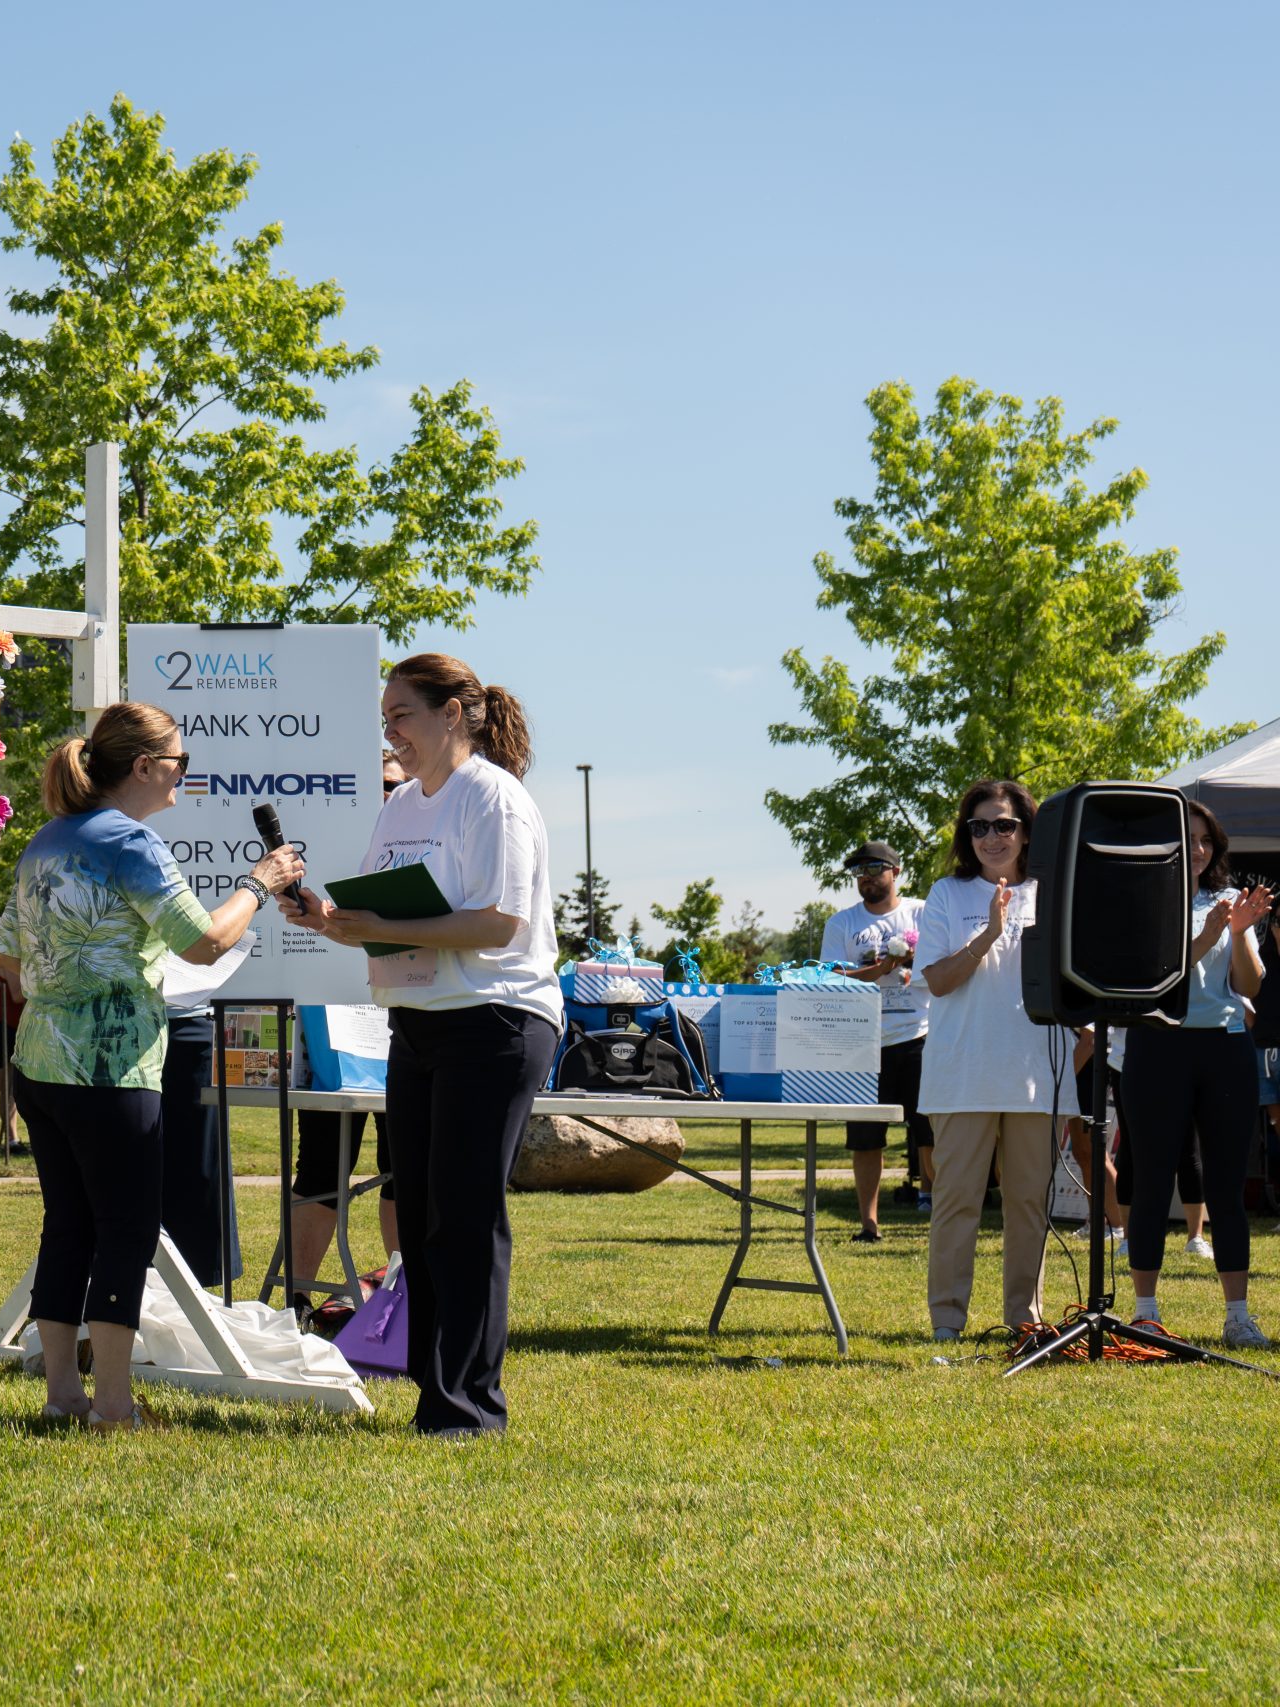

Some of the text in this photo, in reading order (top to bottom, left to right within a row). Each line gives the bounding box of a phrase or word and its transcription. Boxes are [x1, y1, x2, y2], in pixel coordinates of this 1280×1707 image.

[166, 651, 274, 690] 2 WALK
[197, 678, 278, 689] REMEMBER
[177, 714, 320, 737] HANK YOU
[196, 799, 357, 807] ENEFITS
[163, 841, 307, 863] OR YOR
